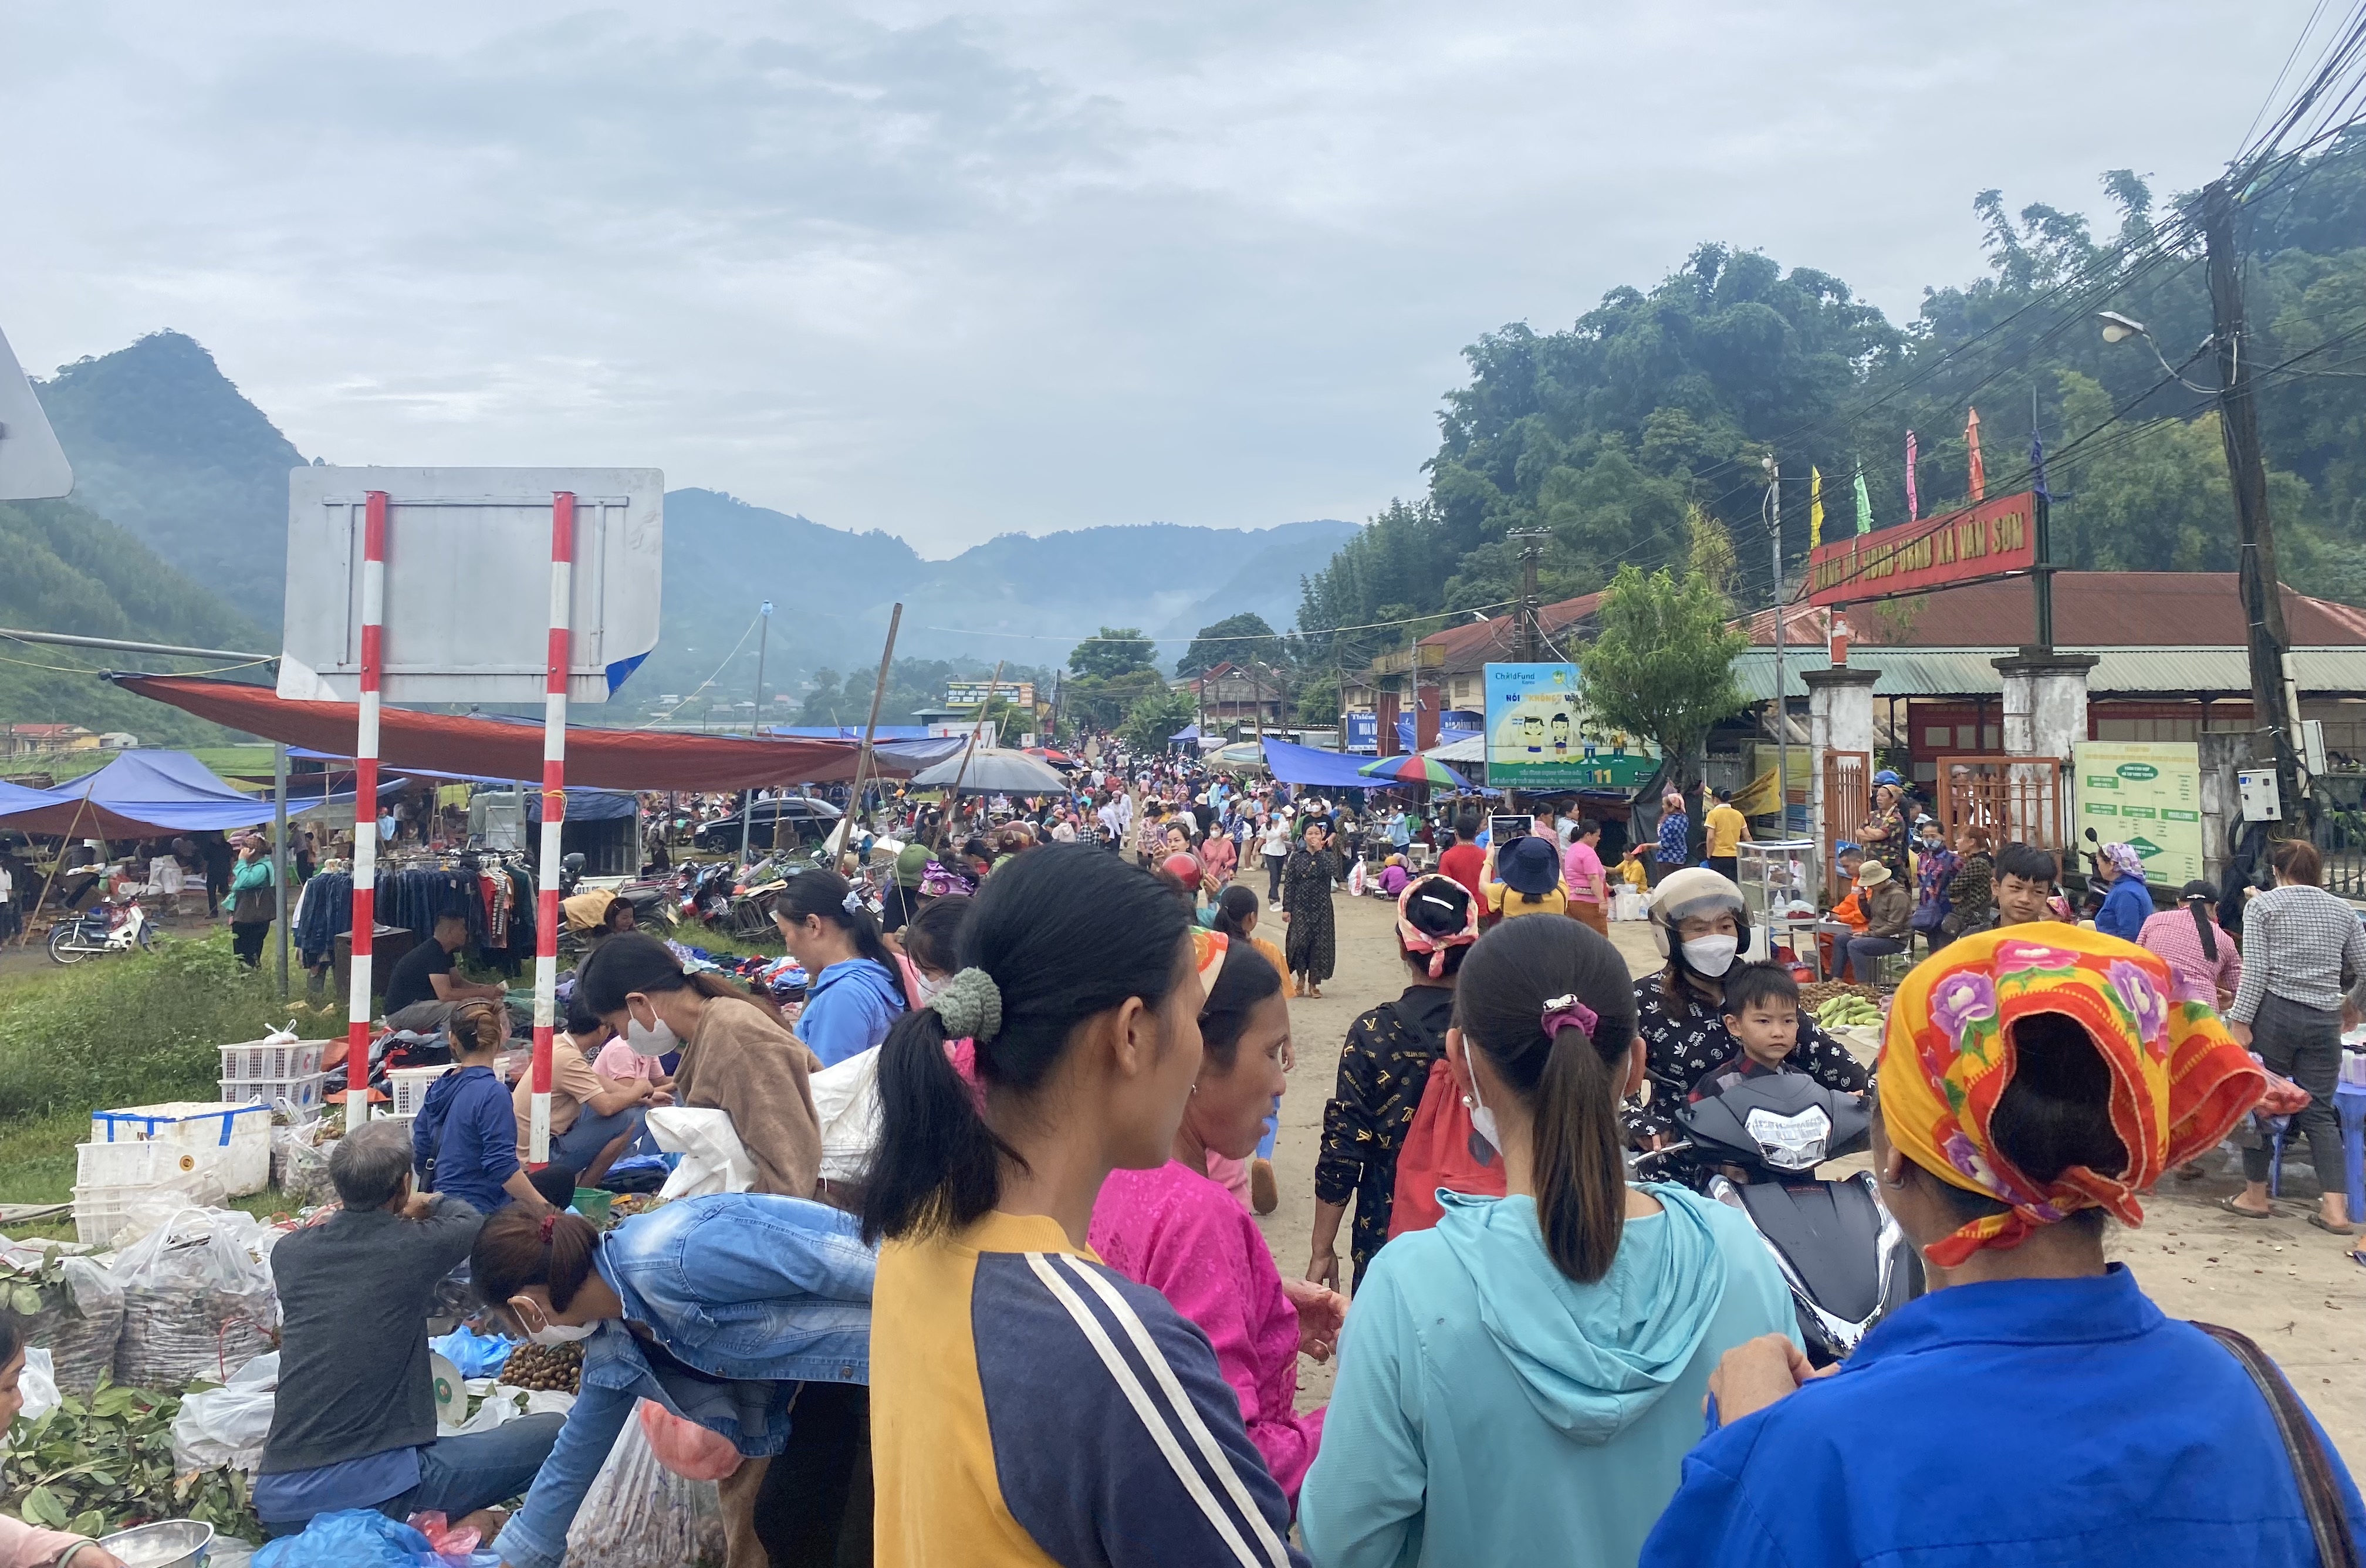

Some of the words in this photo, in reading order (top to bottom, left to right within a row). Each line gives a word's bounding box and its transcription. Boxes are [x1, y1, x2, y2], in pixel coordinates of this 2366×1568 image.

[1959, 515, 1986, 559] VÂN
[1992, 512, 2024, 553] SƠN
[1506, 692, 1520, 702] NÓI
[1358, 723, 1371, 735] MUA
[1586, 769, 1611, 784] 111
